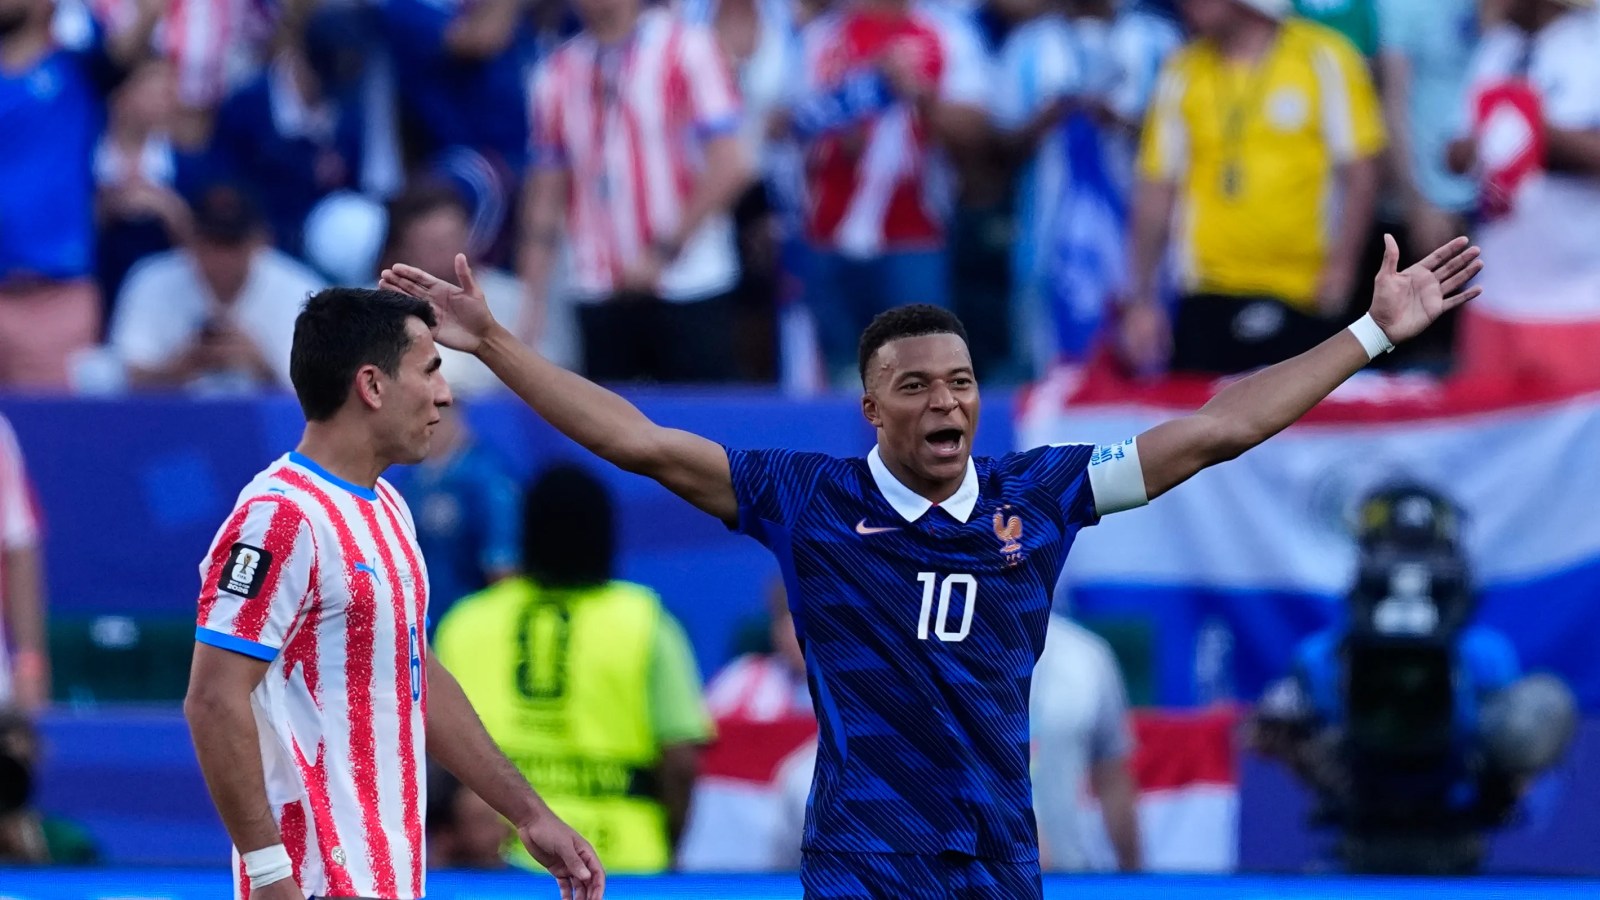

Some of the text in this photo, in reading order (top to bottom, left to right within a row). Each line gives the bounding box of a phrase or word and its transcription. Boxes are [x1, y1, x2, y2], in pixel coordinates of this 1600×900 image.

[227, 583, 248, 594] 2026
[917, 572, 978, 642] 10
[409, 625, 421, 702] 6
